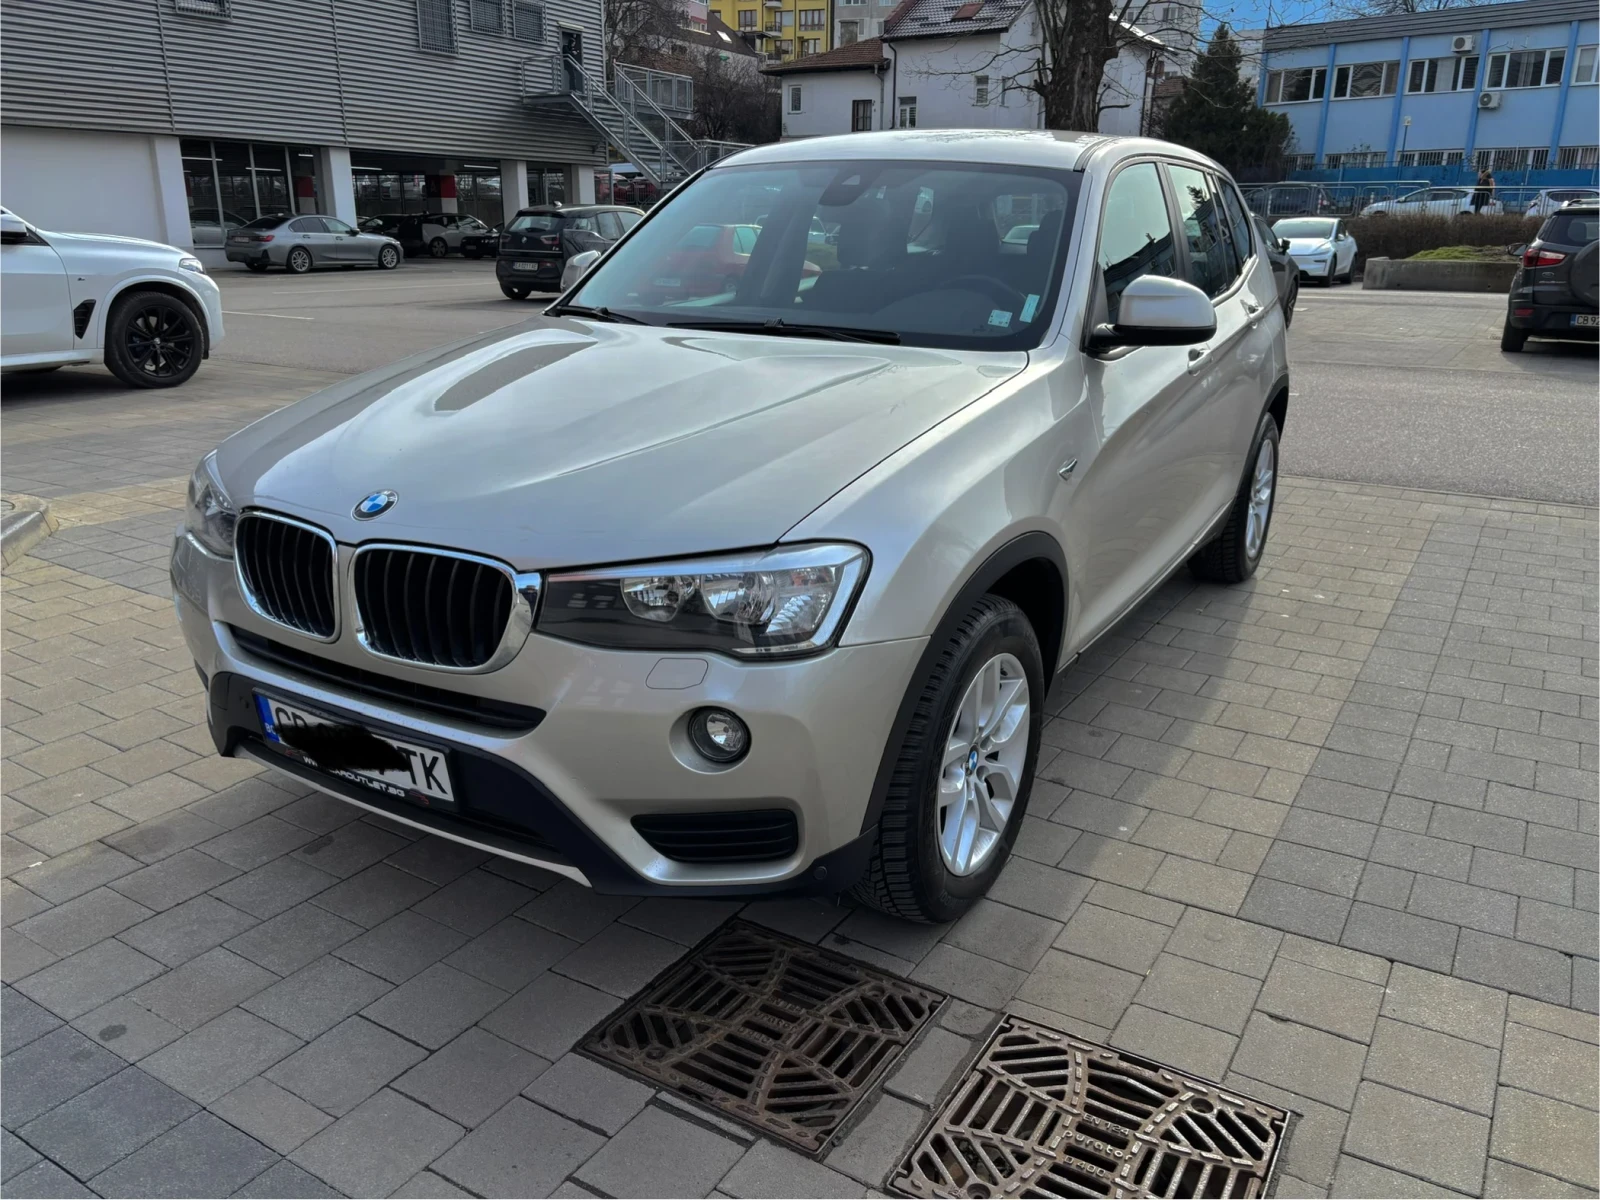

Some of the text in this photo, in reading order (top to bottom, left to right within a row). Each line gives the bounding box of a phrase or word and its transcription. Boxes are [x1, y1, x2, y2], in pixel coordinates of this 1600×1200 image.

[1576, 315, 1589, 325] CB
[396, 746, 449, 795] TK
[1083, 1113, 1129, 1135] EN 124
[1061, 1130, 1133, 1161] purator
[1064, 1155, 1106, 1177] D 400
